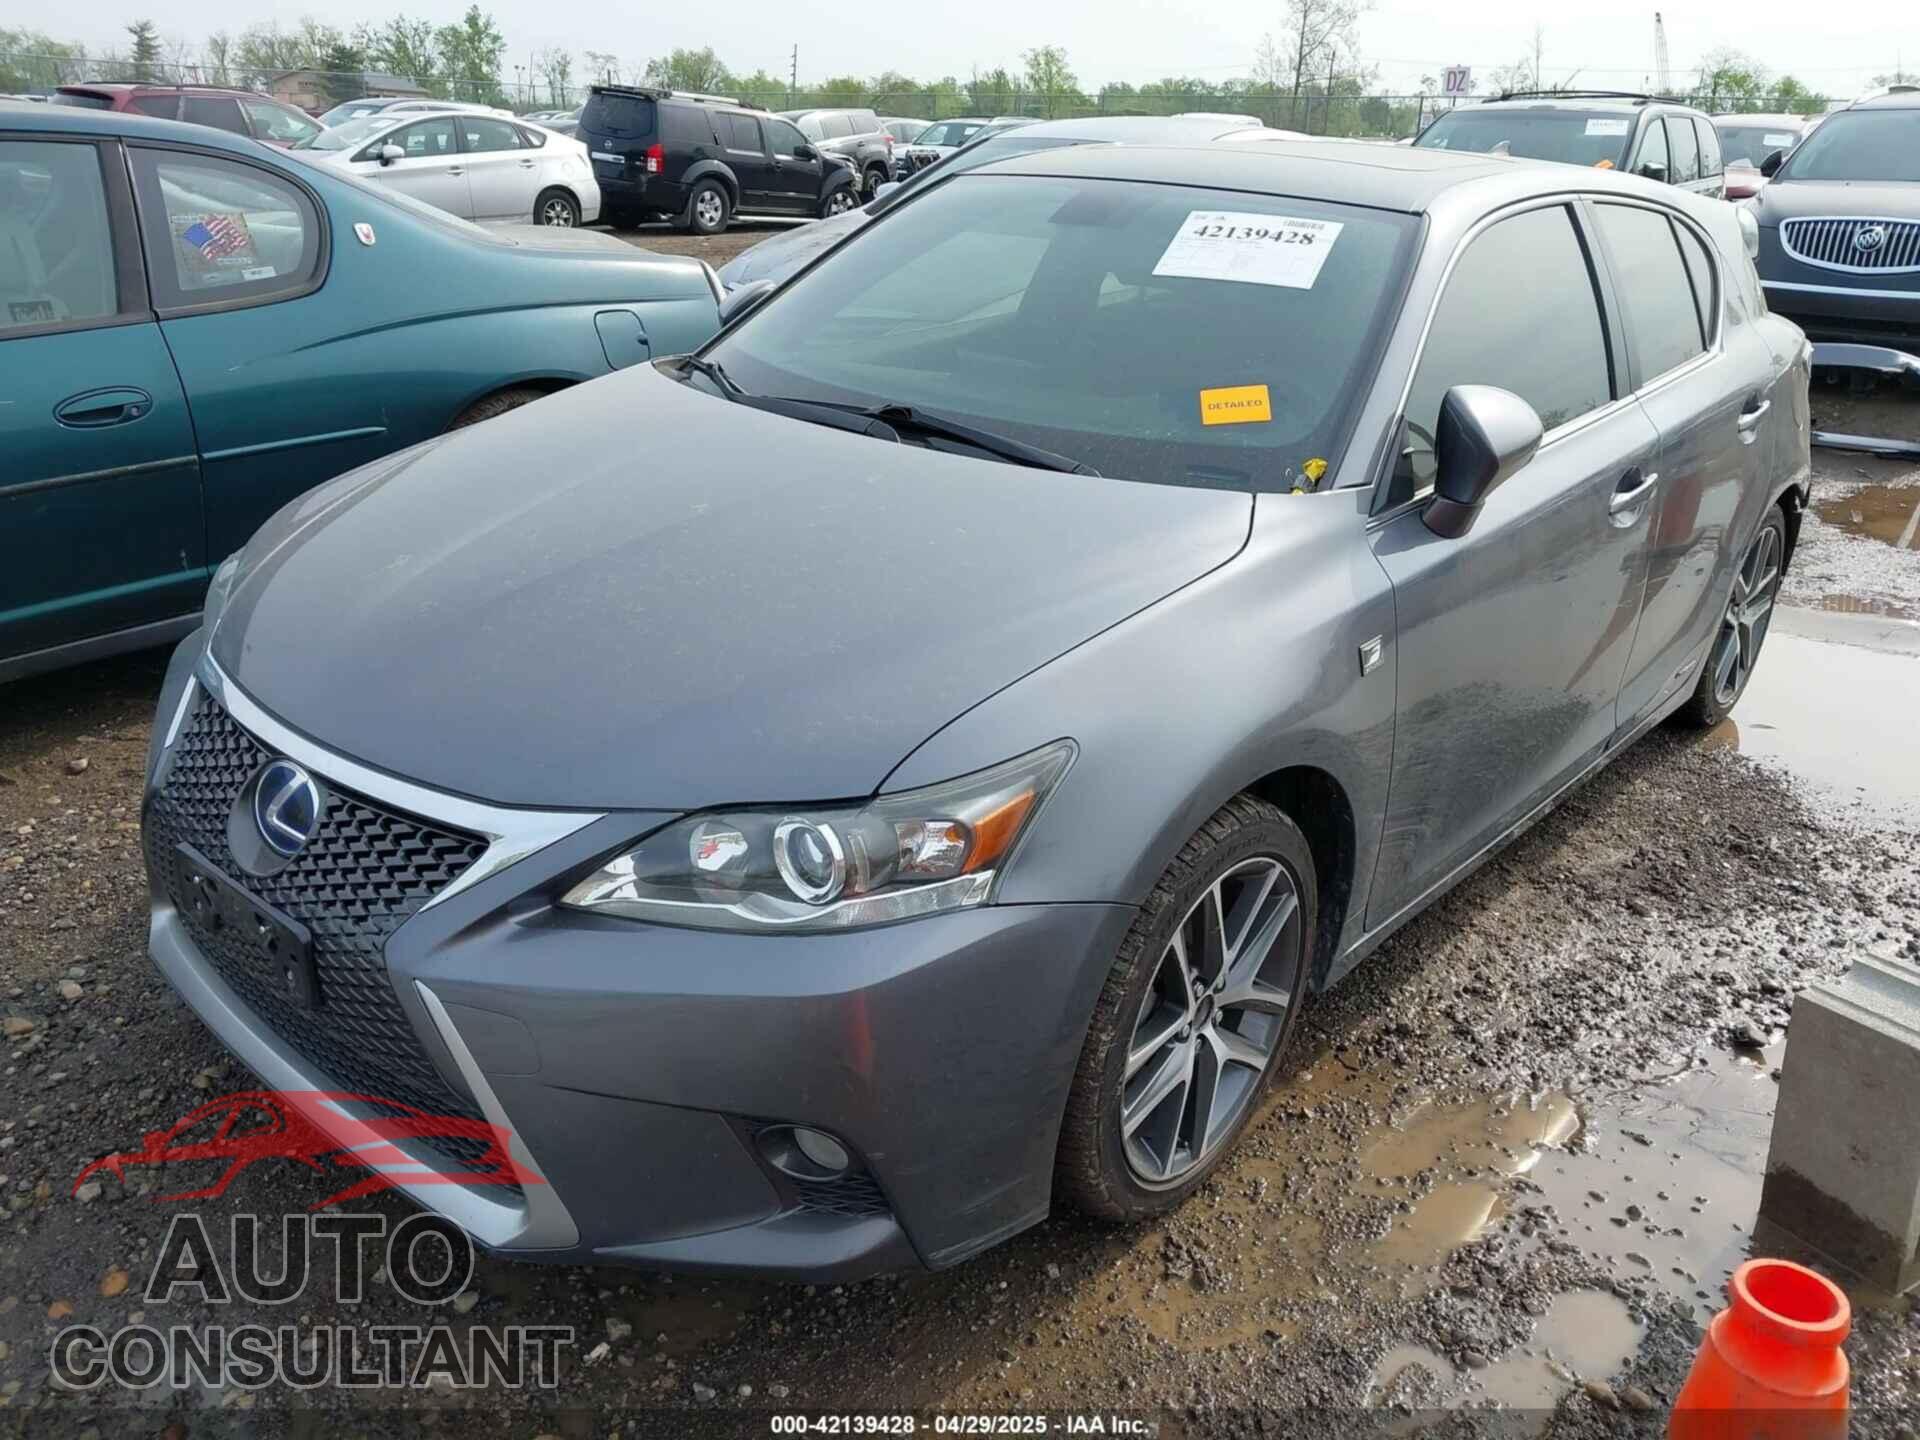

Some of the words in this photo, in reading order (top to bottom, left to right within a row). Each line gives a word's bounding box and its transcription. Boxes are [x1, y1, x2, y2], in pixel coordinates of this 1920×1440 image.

[1446, 70, 1467, 92] DZ
[1193, 224, 1316, 246] 42139428
[1207, 398, 1263, 411] DETAILED
